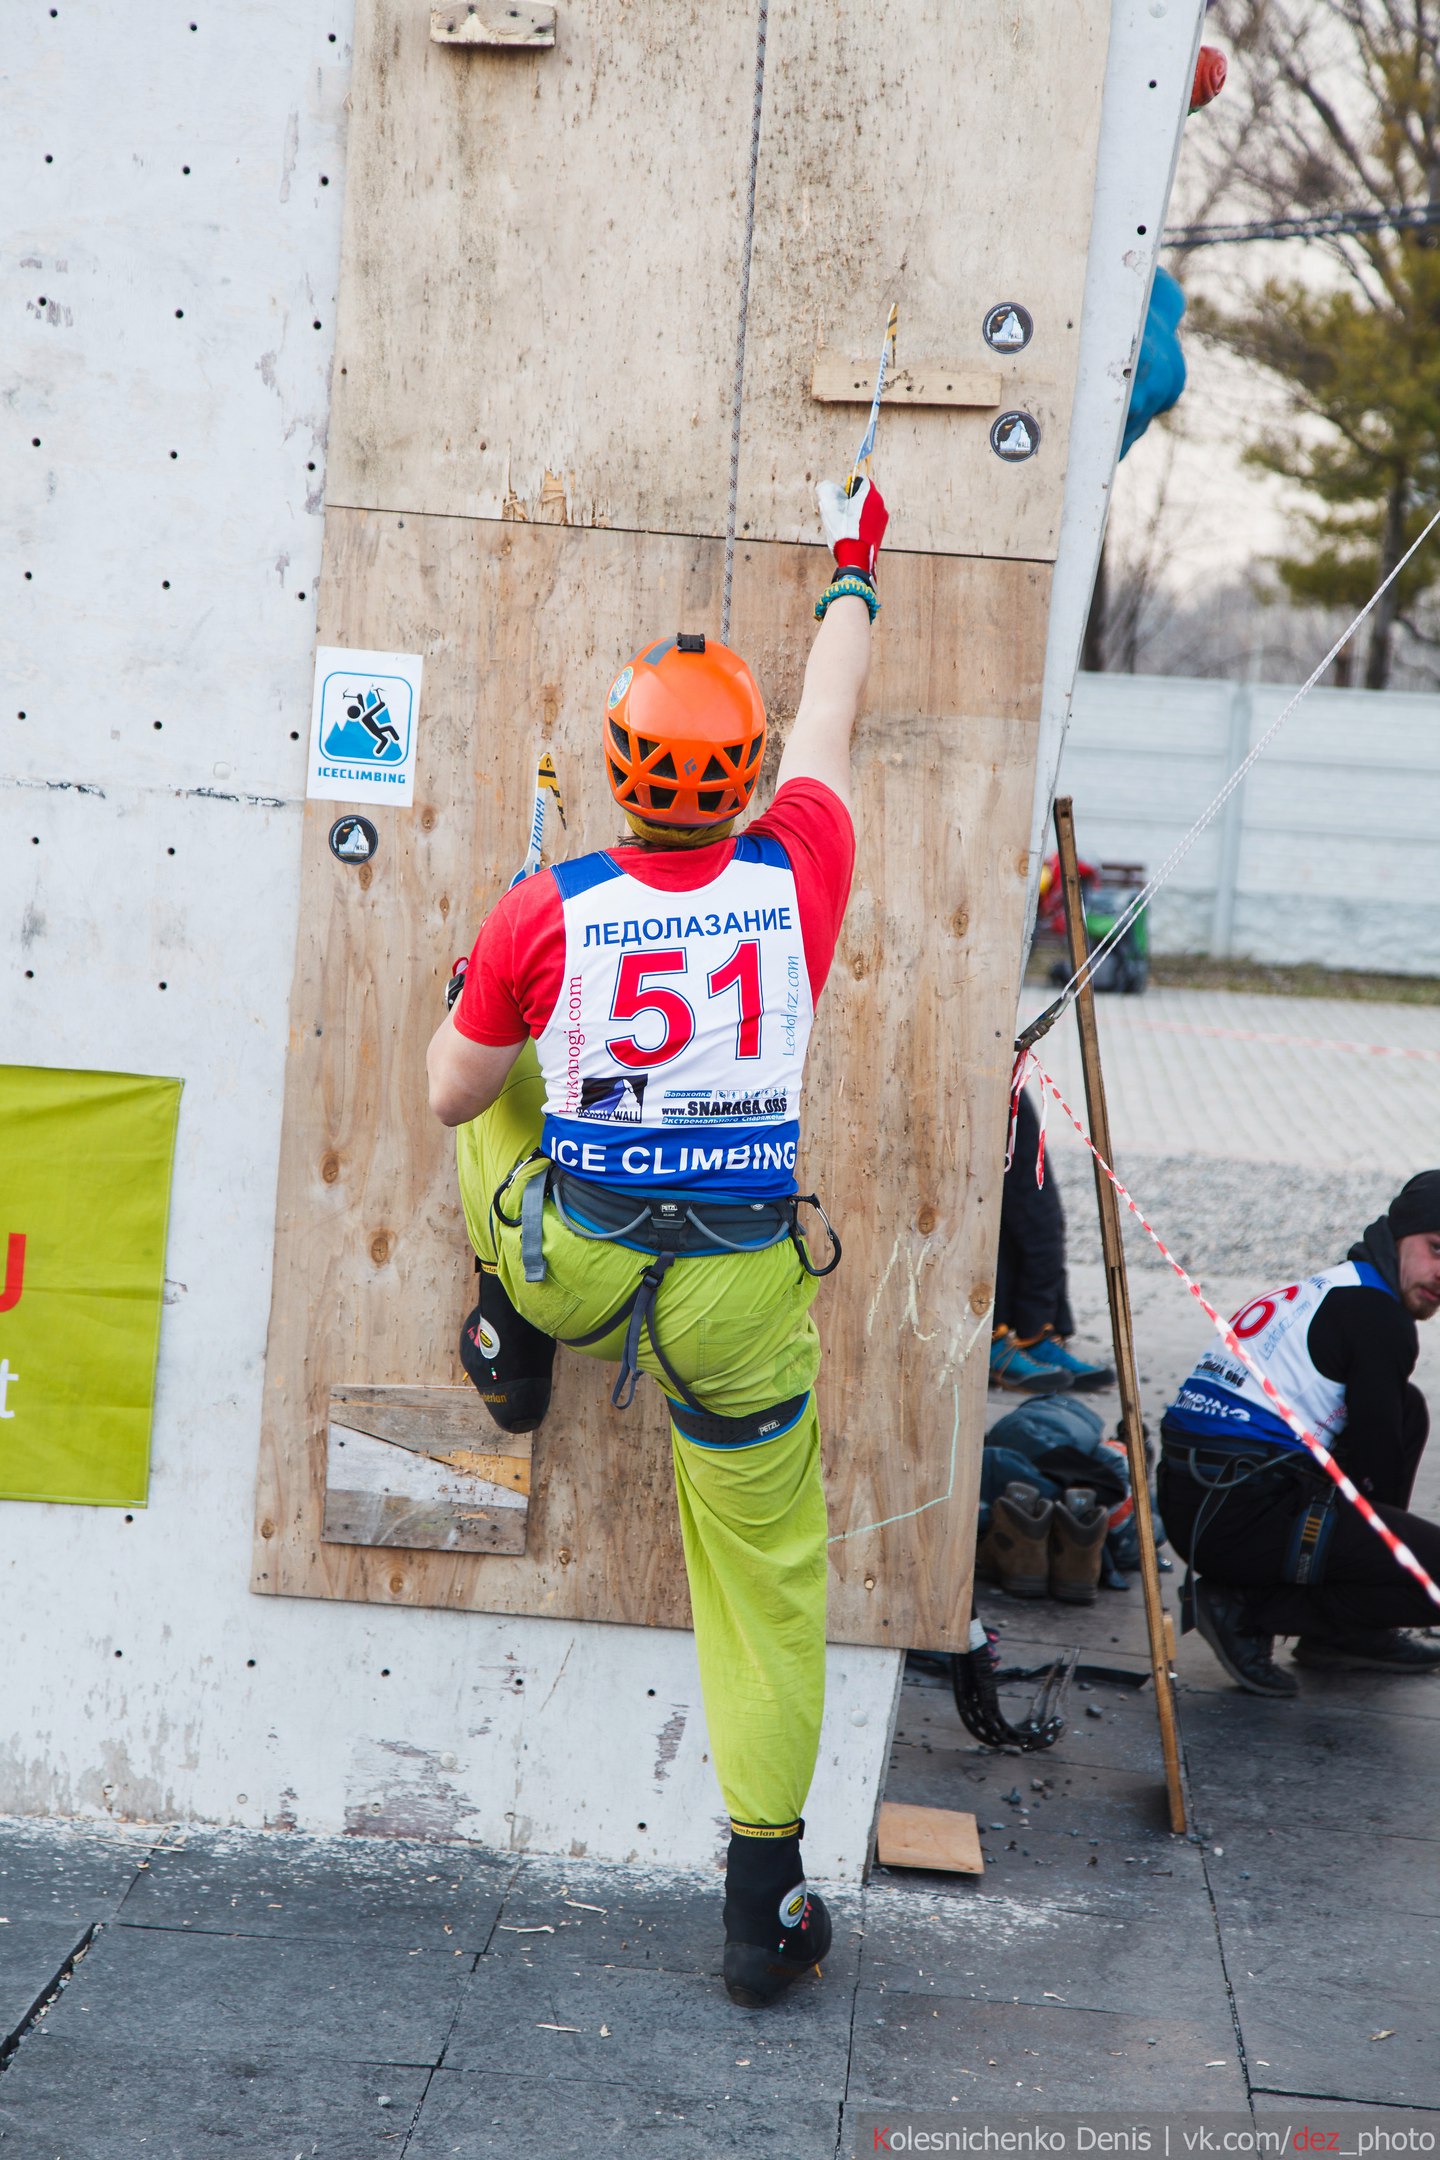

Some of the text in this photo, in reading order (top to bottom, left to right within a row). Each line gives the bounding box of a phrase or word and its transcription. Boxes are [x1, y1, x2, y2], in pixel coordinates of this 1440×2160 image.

[318, 767, 406, 784] ICECLIMBING
[583, 907, 792, 947] ЛЕДОЛАЗАНИЕ
[605, 938, 765, 1070] 51
[613, 1110, 641, 1122] WALL
[551, 1136, 796, 1175] ICE CLIMBING
[759, 1420, 780, 1436] PETZL
